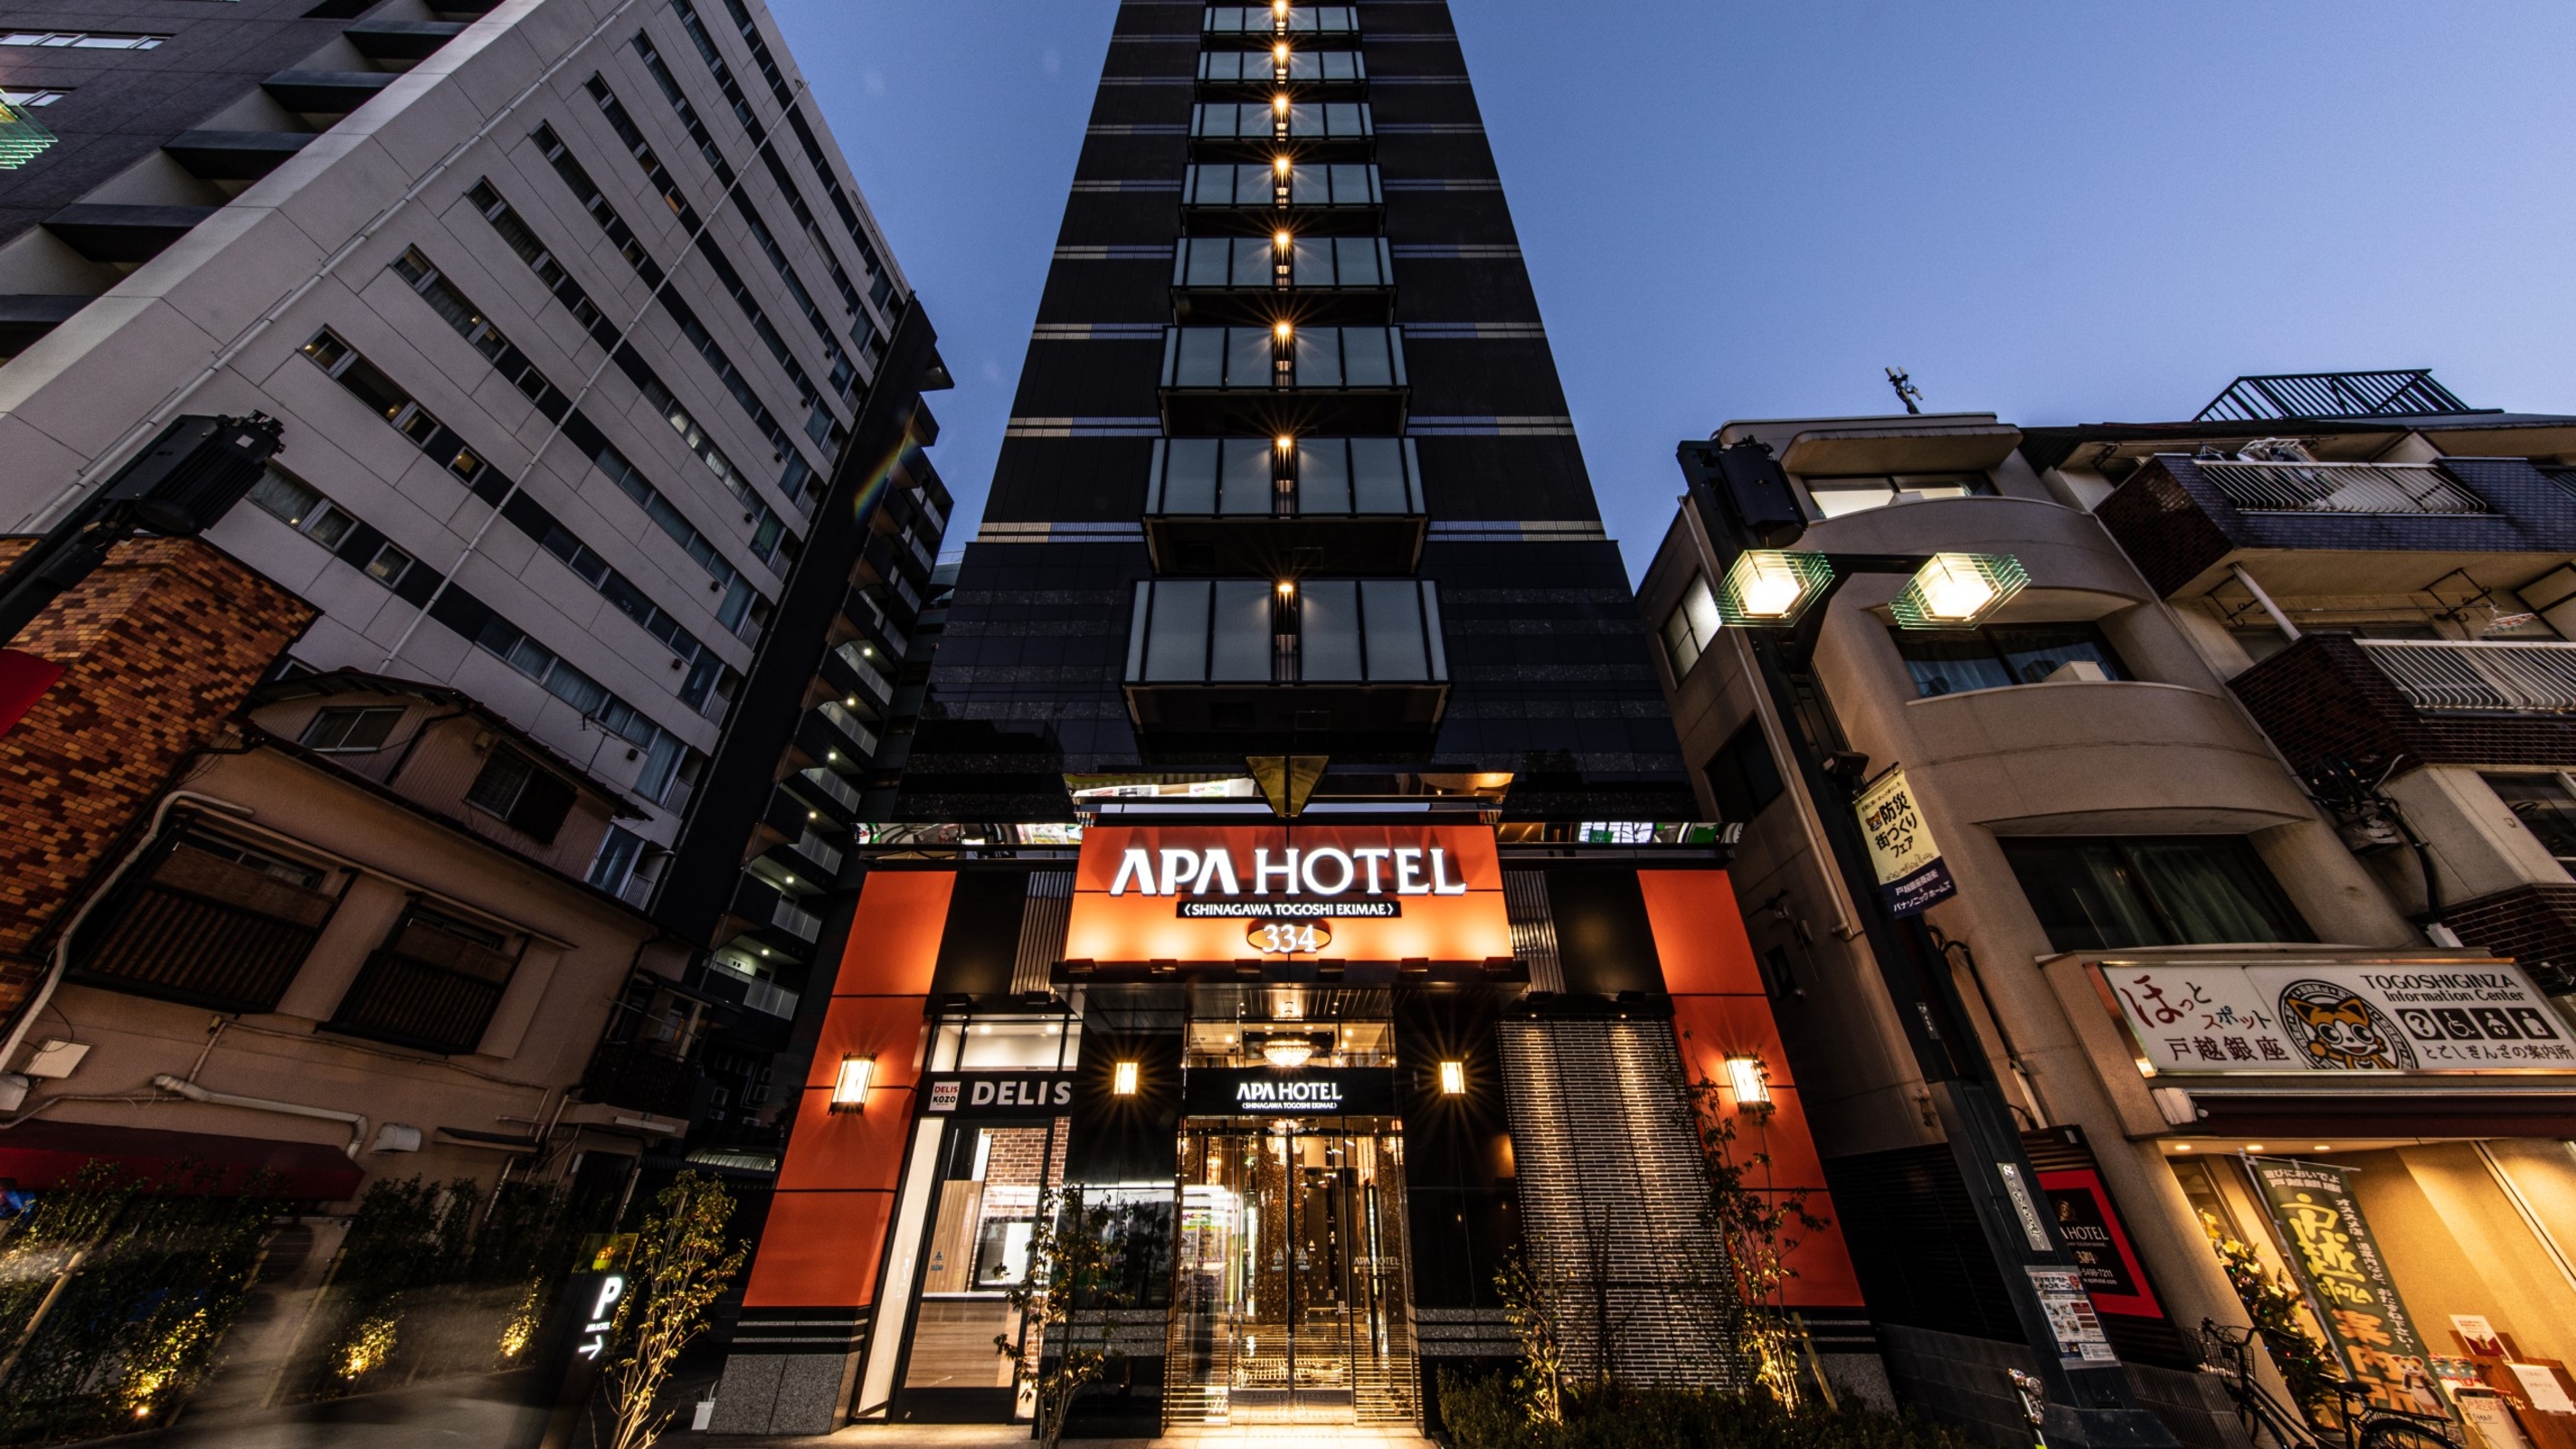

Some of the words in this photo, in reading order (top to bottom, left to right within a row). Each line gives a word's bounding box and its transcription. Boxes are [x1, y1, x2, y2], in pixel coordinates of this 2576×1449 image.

[1879, 791, 1911, 825] 防災
[1875, 812, 1917, 851] 街づくり
[1890, 835, 1913, 858] フェア
[1109, 848, 1240, 895] APA
[1254, 848, 1467, 895] HOTEL
[1274, 904, 1334, 916] TOGOSHI
[1262, 923, 1318, 953] 334
[2359, 974, 2519, 990] TOGOSHIGINZA
[2119, 974, 2211, 1028] ほっと
[2382, 990, 2475, 1002] Information
[2475, 989, 2525, 1001] Center
[2201, 1005, 2272, 1029] スポット
[2164, 1036, 2290, 1061] 戸越銀座
[2422, 1044, 2575, 1060] とごしぎんざの案内所
[933, 1095, 956, 1103] KOZO
[934, 1085, 959, 1094] DELIS
[971, 1081, 1071, 1105] DELIS
[1236, 1083, 1275, 1100] APA
[1278, 1082, 1343, 1100] HOTEL
[2067, 1226, 2109, 1240] HOTEL
[1354, 1256, 1370, 1265] APA
[592, 1276, 623, 1320] P
